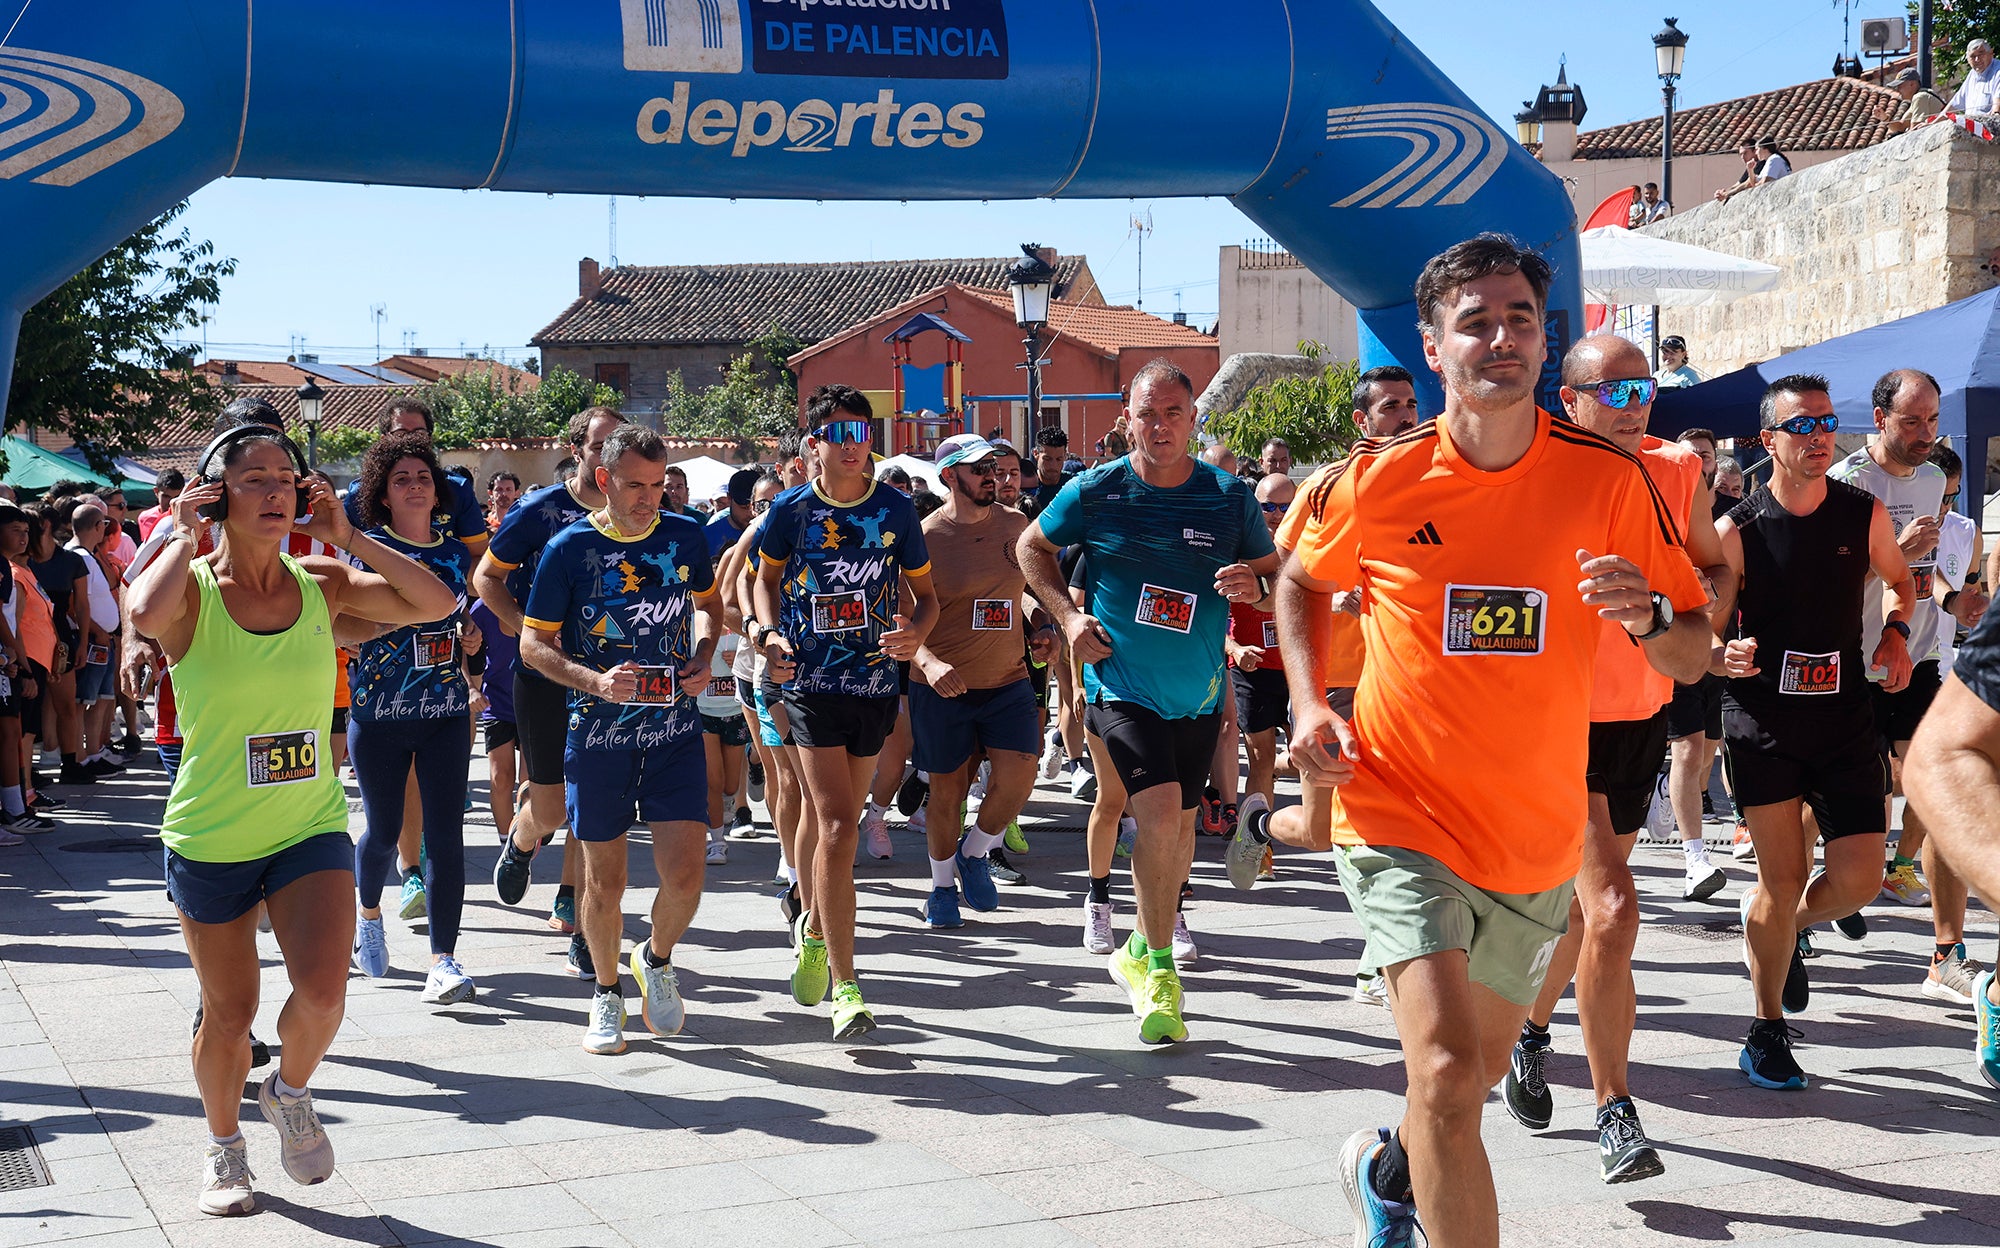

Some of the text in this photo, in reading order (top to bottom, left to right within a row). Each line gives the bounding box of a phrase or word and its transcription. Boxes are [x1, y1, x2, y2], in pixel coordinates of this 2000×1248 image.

[765, 21, 1000, 57] DE PALENCIA
[636, 81, 986, 157] deportes
[1543, 317, 1562, 418] ENCIA
[822, 553, 887, 588] RUN
[624, 589, 687, 628] RUN
[829, 602, 863, 621] 149
[985, 608, 1009, 621] 267
[1154, 599, 1191, 622] 038
[1472, 606, 1534, 636] 621
[430, 640, 451, 657] 148
[1471, 635, 1536, 650] VILLALOBÓN
[639, 677, 671, 694] 143
[795, 662, 893, 698] better together
[1802, 665, 1837, 684] 102
[374, 688, 466, 720] better together
[585, 710, 695, 749] better together
[269, 743, 315, 771] 510
